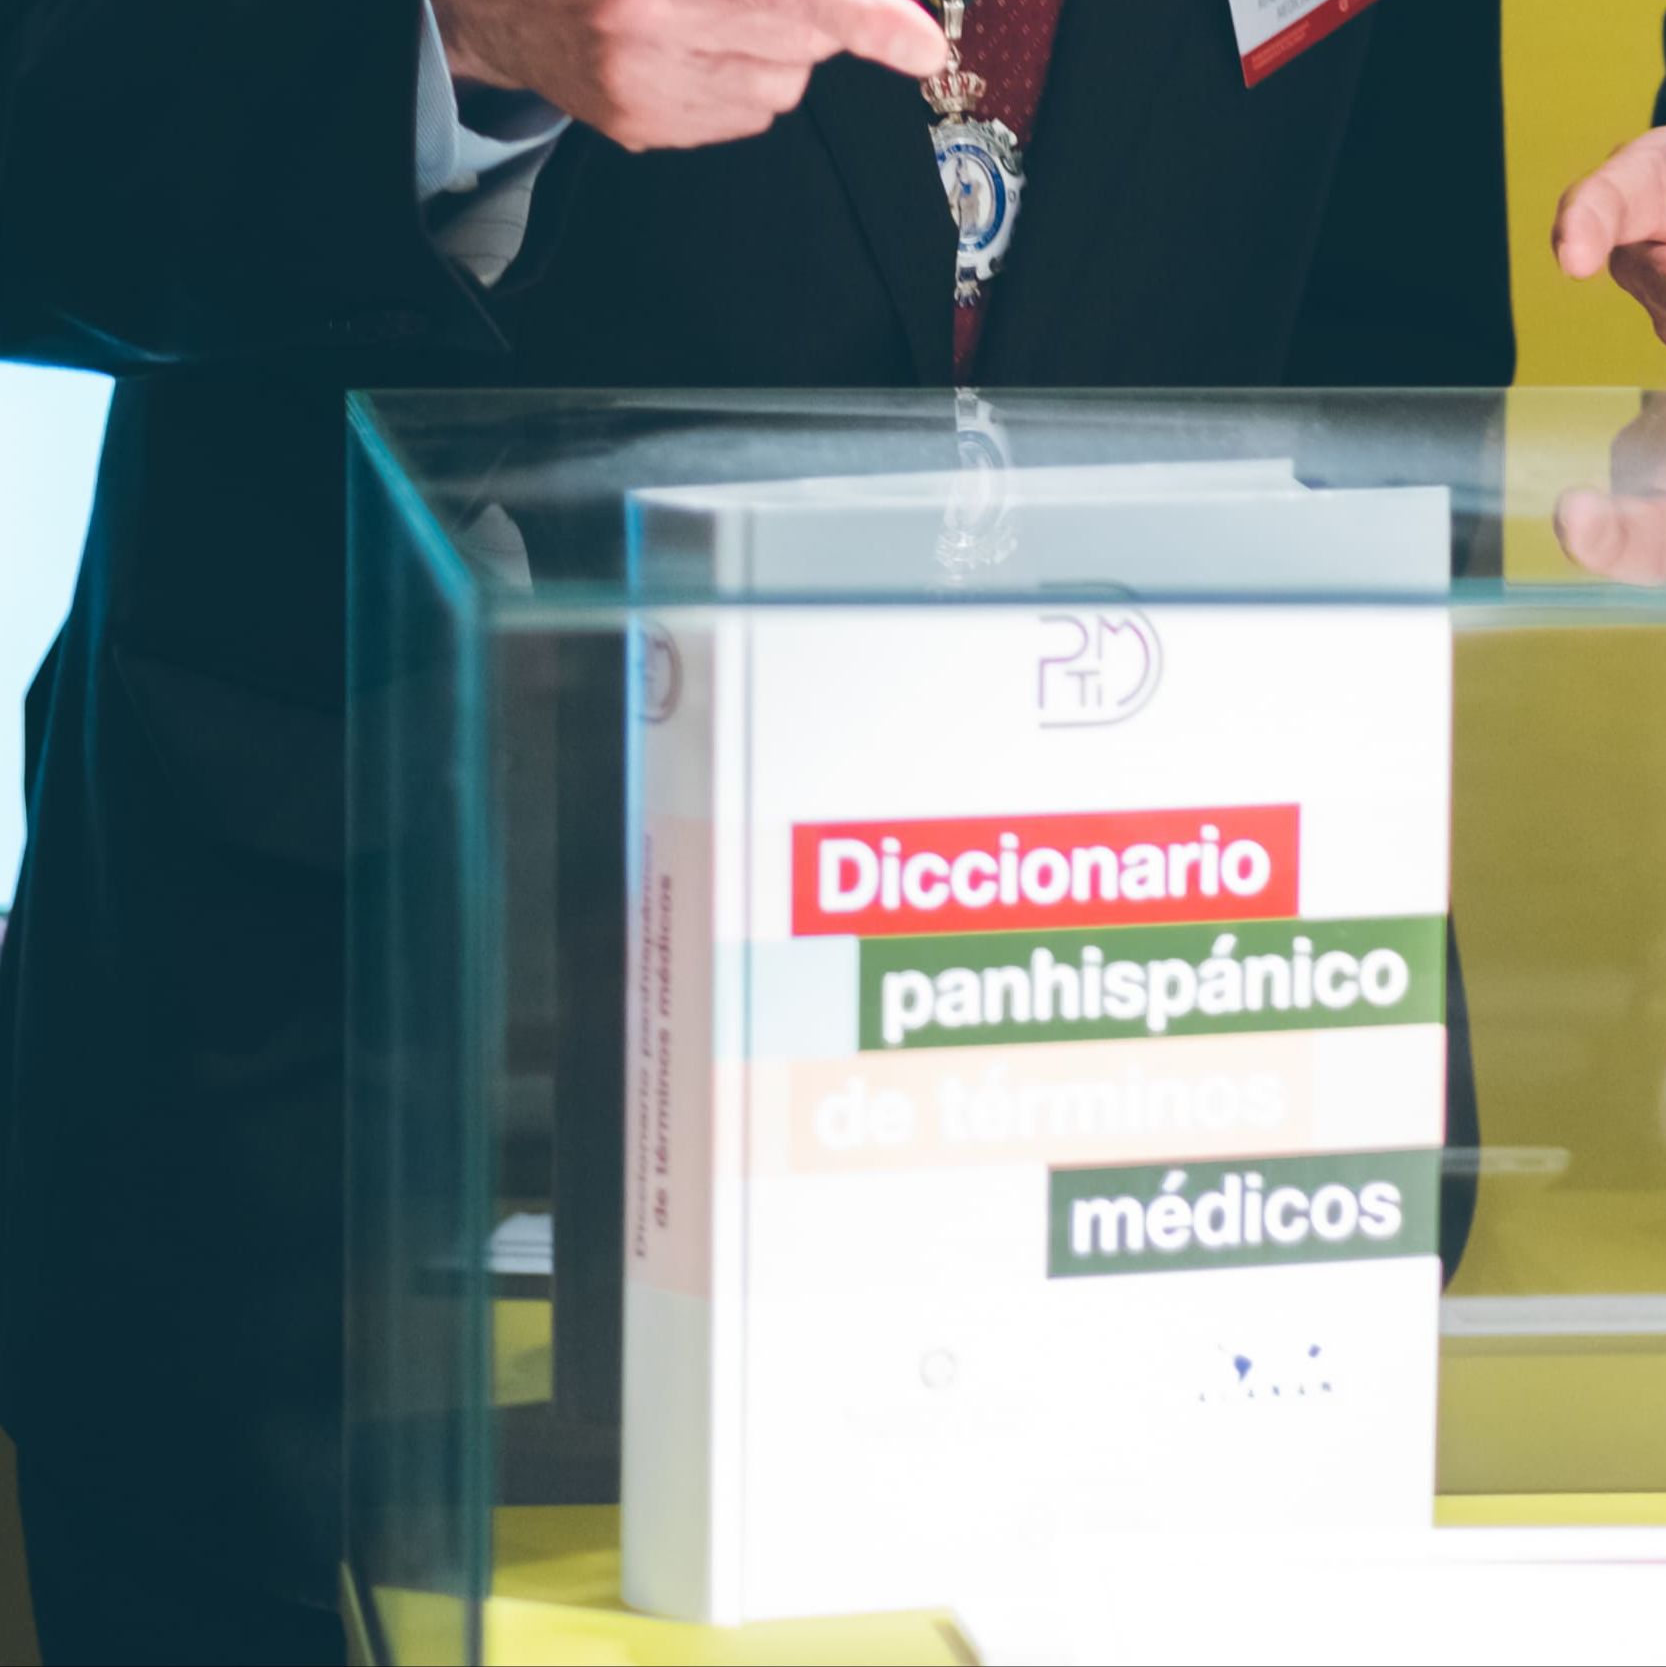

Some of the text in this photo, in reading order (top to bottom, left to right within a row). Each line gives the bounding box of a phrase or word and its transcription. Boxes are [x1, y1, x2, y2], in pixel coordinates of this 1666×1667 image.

[817, 823, 1271, 914] Diccionario
[881, 932, 1411, 1047] panhispánico
[654, 874, 673, 1230] de términos médicos
[813, 1058, 1286, 1151] de términos
[1069, 1168, 1403, 1257] médicos
